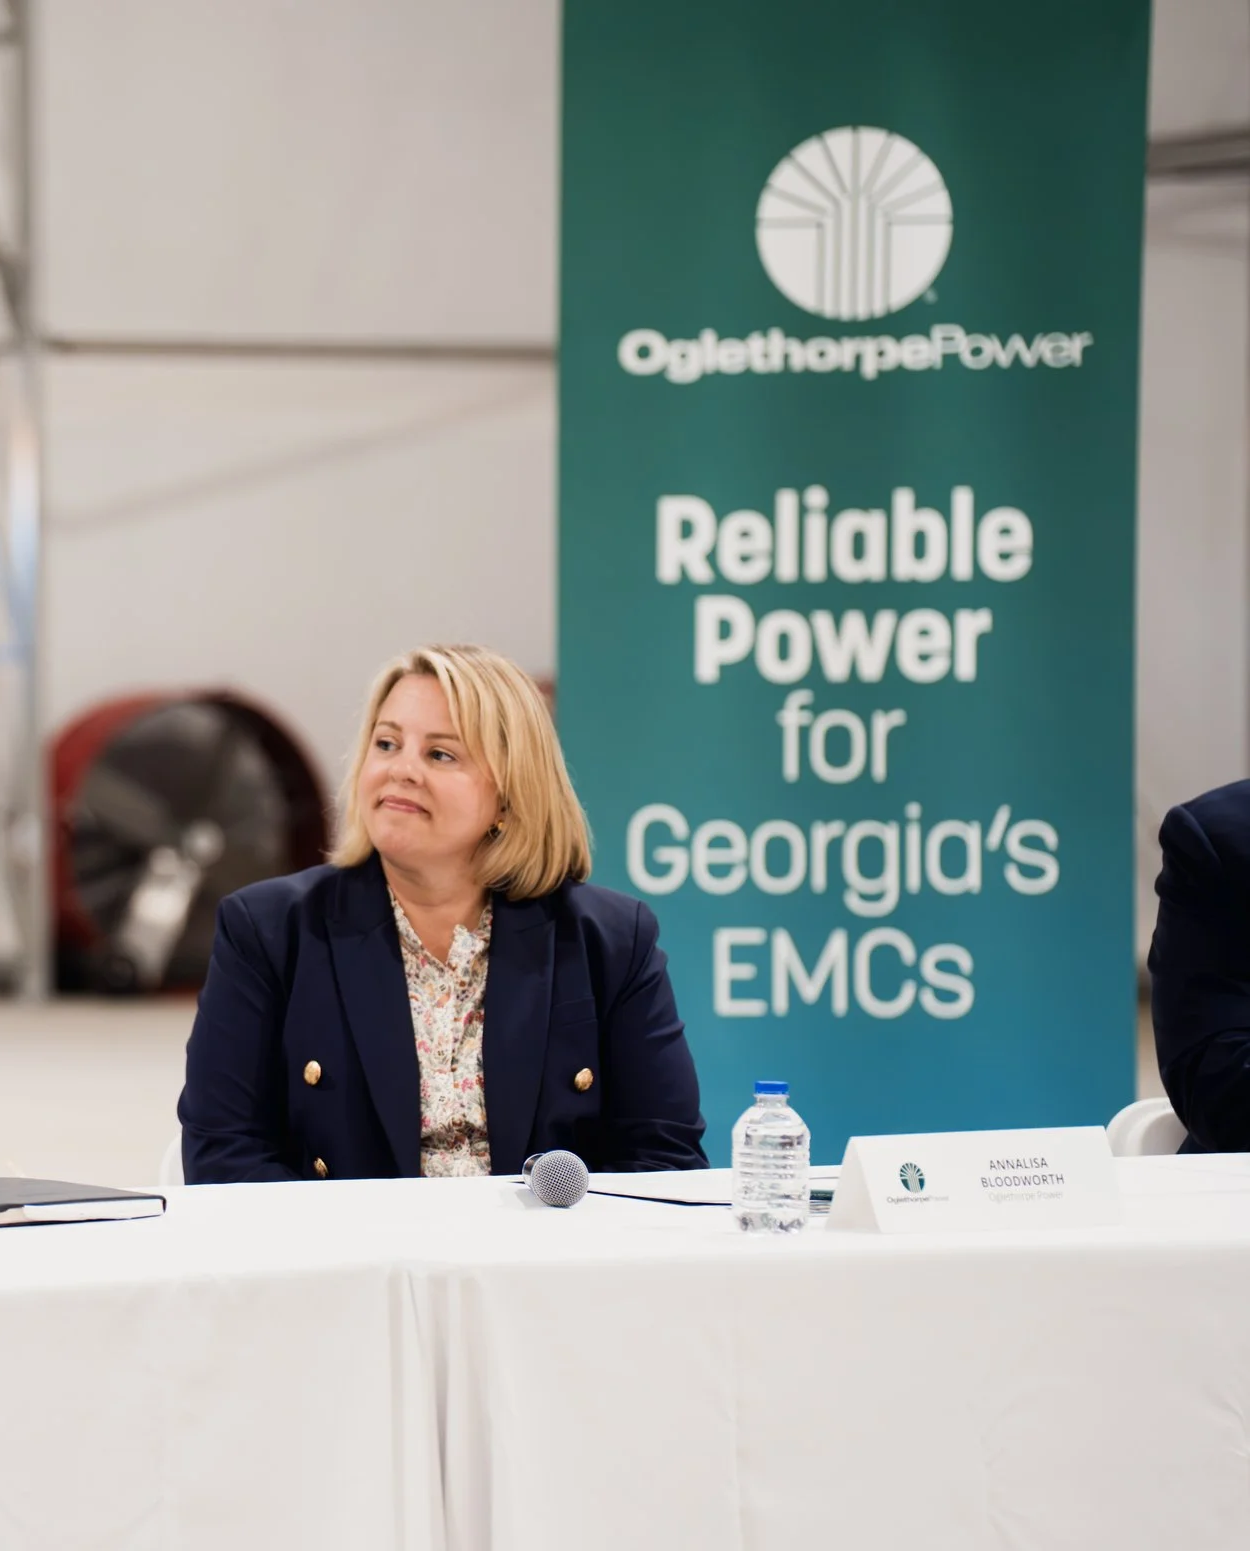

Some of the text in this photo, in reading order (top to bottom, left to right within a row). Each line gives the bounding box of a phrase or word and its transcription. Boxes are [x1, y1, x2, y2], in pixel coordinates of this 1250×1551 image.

[617, 323, 1093, 385] OglethorpePower
[655, 484, 1034, 585] Reliable
[693, 594, 993, 685] Power
[777, 689, 906, 784] for
[712, 926, 975, 1019] EMCs
[980, 1173, 1065, 1188] BLOODWORTH
[989, 1157, 1049, 1171] ANNALISA
